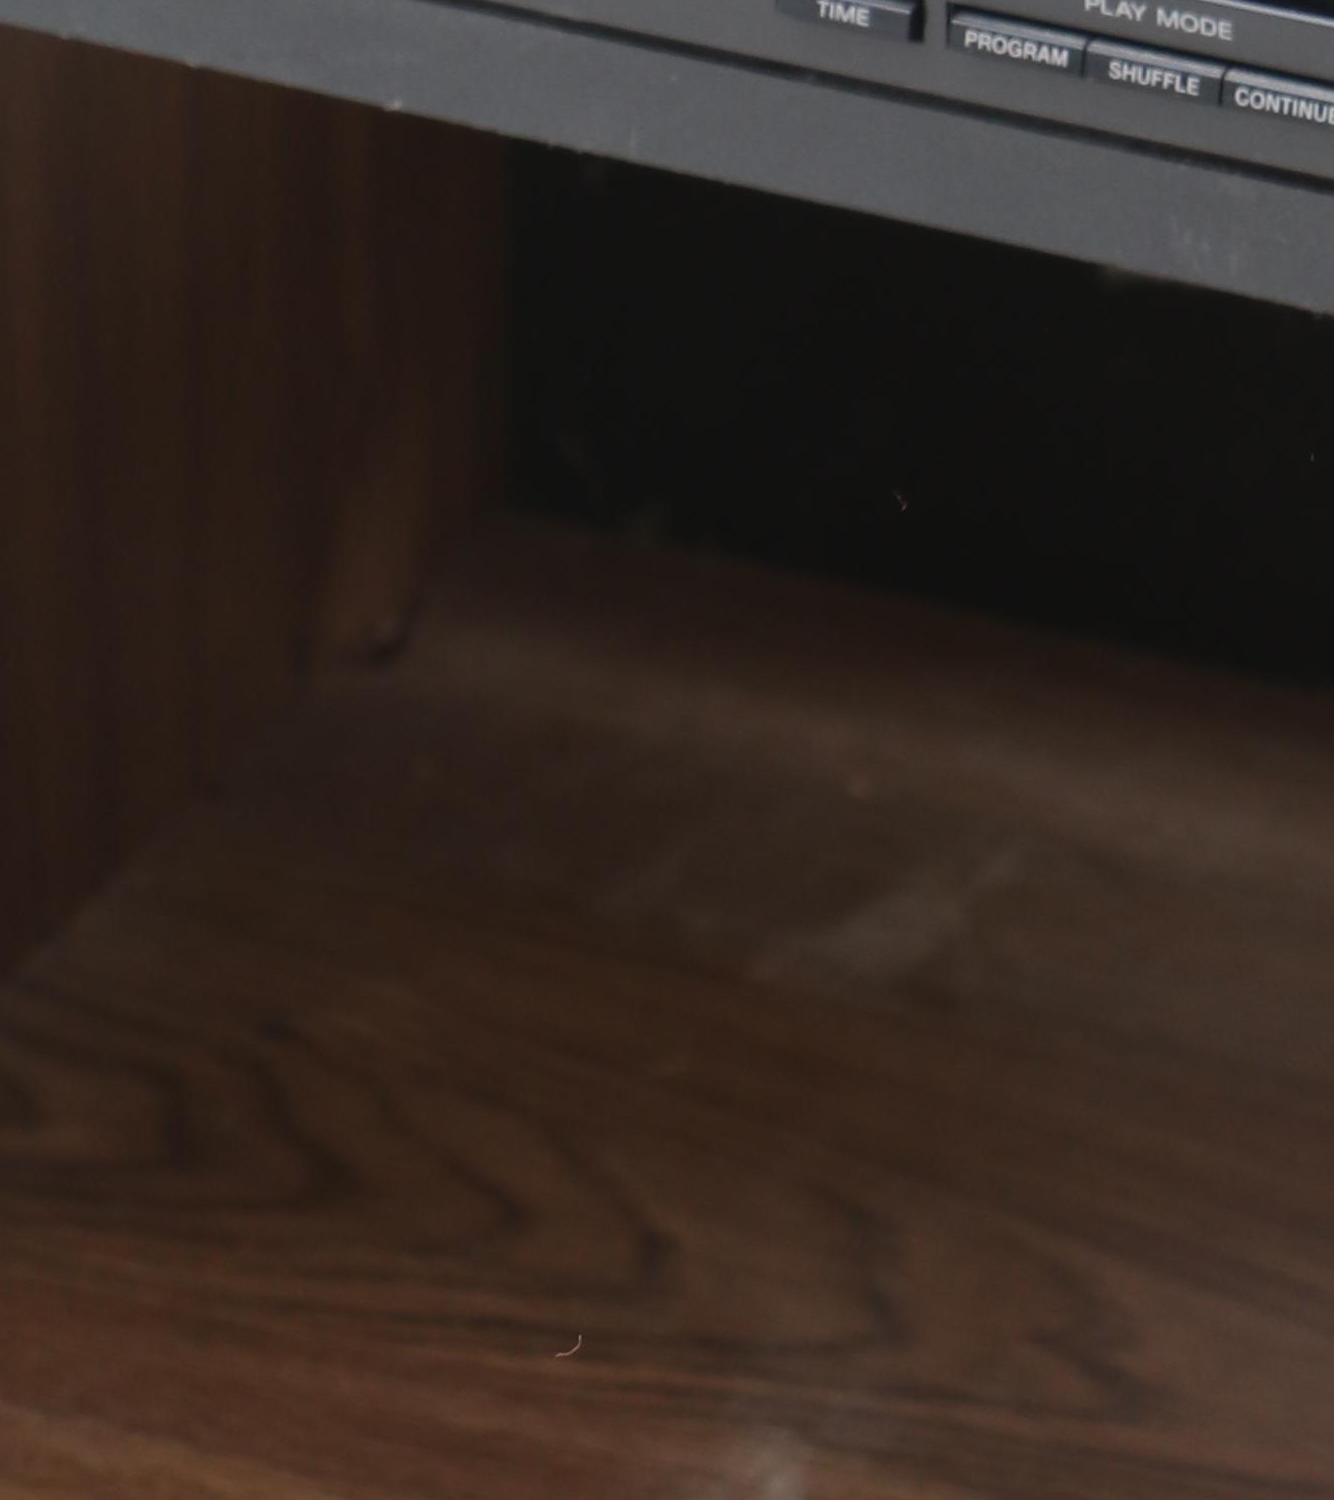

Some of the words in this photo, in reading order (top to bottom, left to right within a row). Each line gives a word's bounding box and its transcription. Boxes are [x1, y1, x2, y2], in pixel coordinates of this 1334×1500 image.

[1156, 9, 1234, 42] MODE
[965, 30, 1068, 68] PROGRAM
[1109, 60, 1200, 98] SHUFFLE
